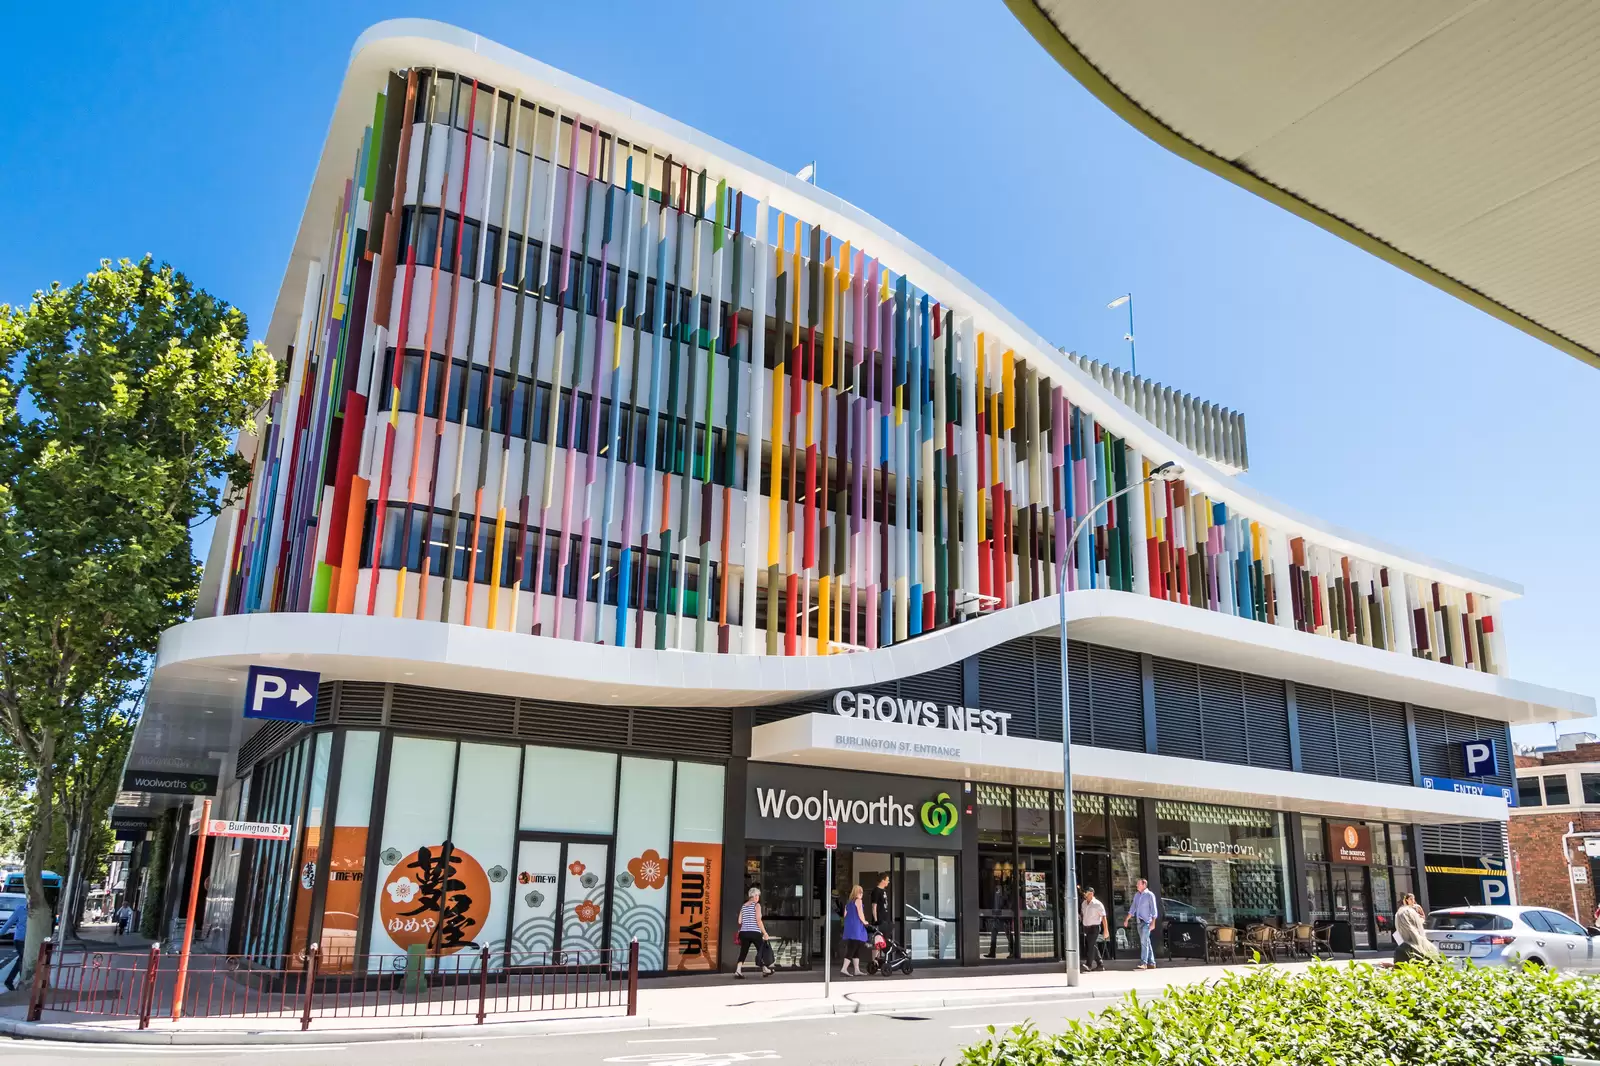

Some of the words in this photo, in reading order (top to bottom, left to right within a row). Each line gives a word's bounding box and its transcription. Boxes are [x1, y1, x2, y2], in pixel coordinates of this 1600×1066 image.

[252, 674, 287, 711] P
[833, 690, 940, 729] CROWS
[945, 705, 1012, 737] NEST
[835, 735, 897, 751] BURLINGTON
[899, 741, 912, 753] ST.
[913, 743, 961, 758] ENTRANCE
[1466, 743, 1490, 774] P
[135, 777, 187, 789] Woolworths
[1453, 783, 1484, 796] ENTRY
[756, 786, 916, 828] Woolworths
[228, 821, 270, 834] Burlington
[271, 825, 281, 834] St
[1180, 838, 1256, 857] OliverBrown
[1349, 849, 1366, 857] source
[330, 871, 364, 882] UME-YA
[530, 875, 557, 884] UME-YA
[704, 858, 712, 890] Japanese
[1482, 879, 1506, 907] P
[678, 856, 706, 955] UME-YA
[703, 905, 712, 926] Asian
[388, 917, 437, 933] ゆめや
[701, 926, 711, 954] Grocery
